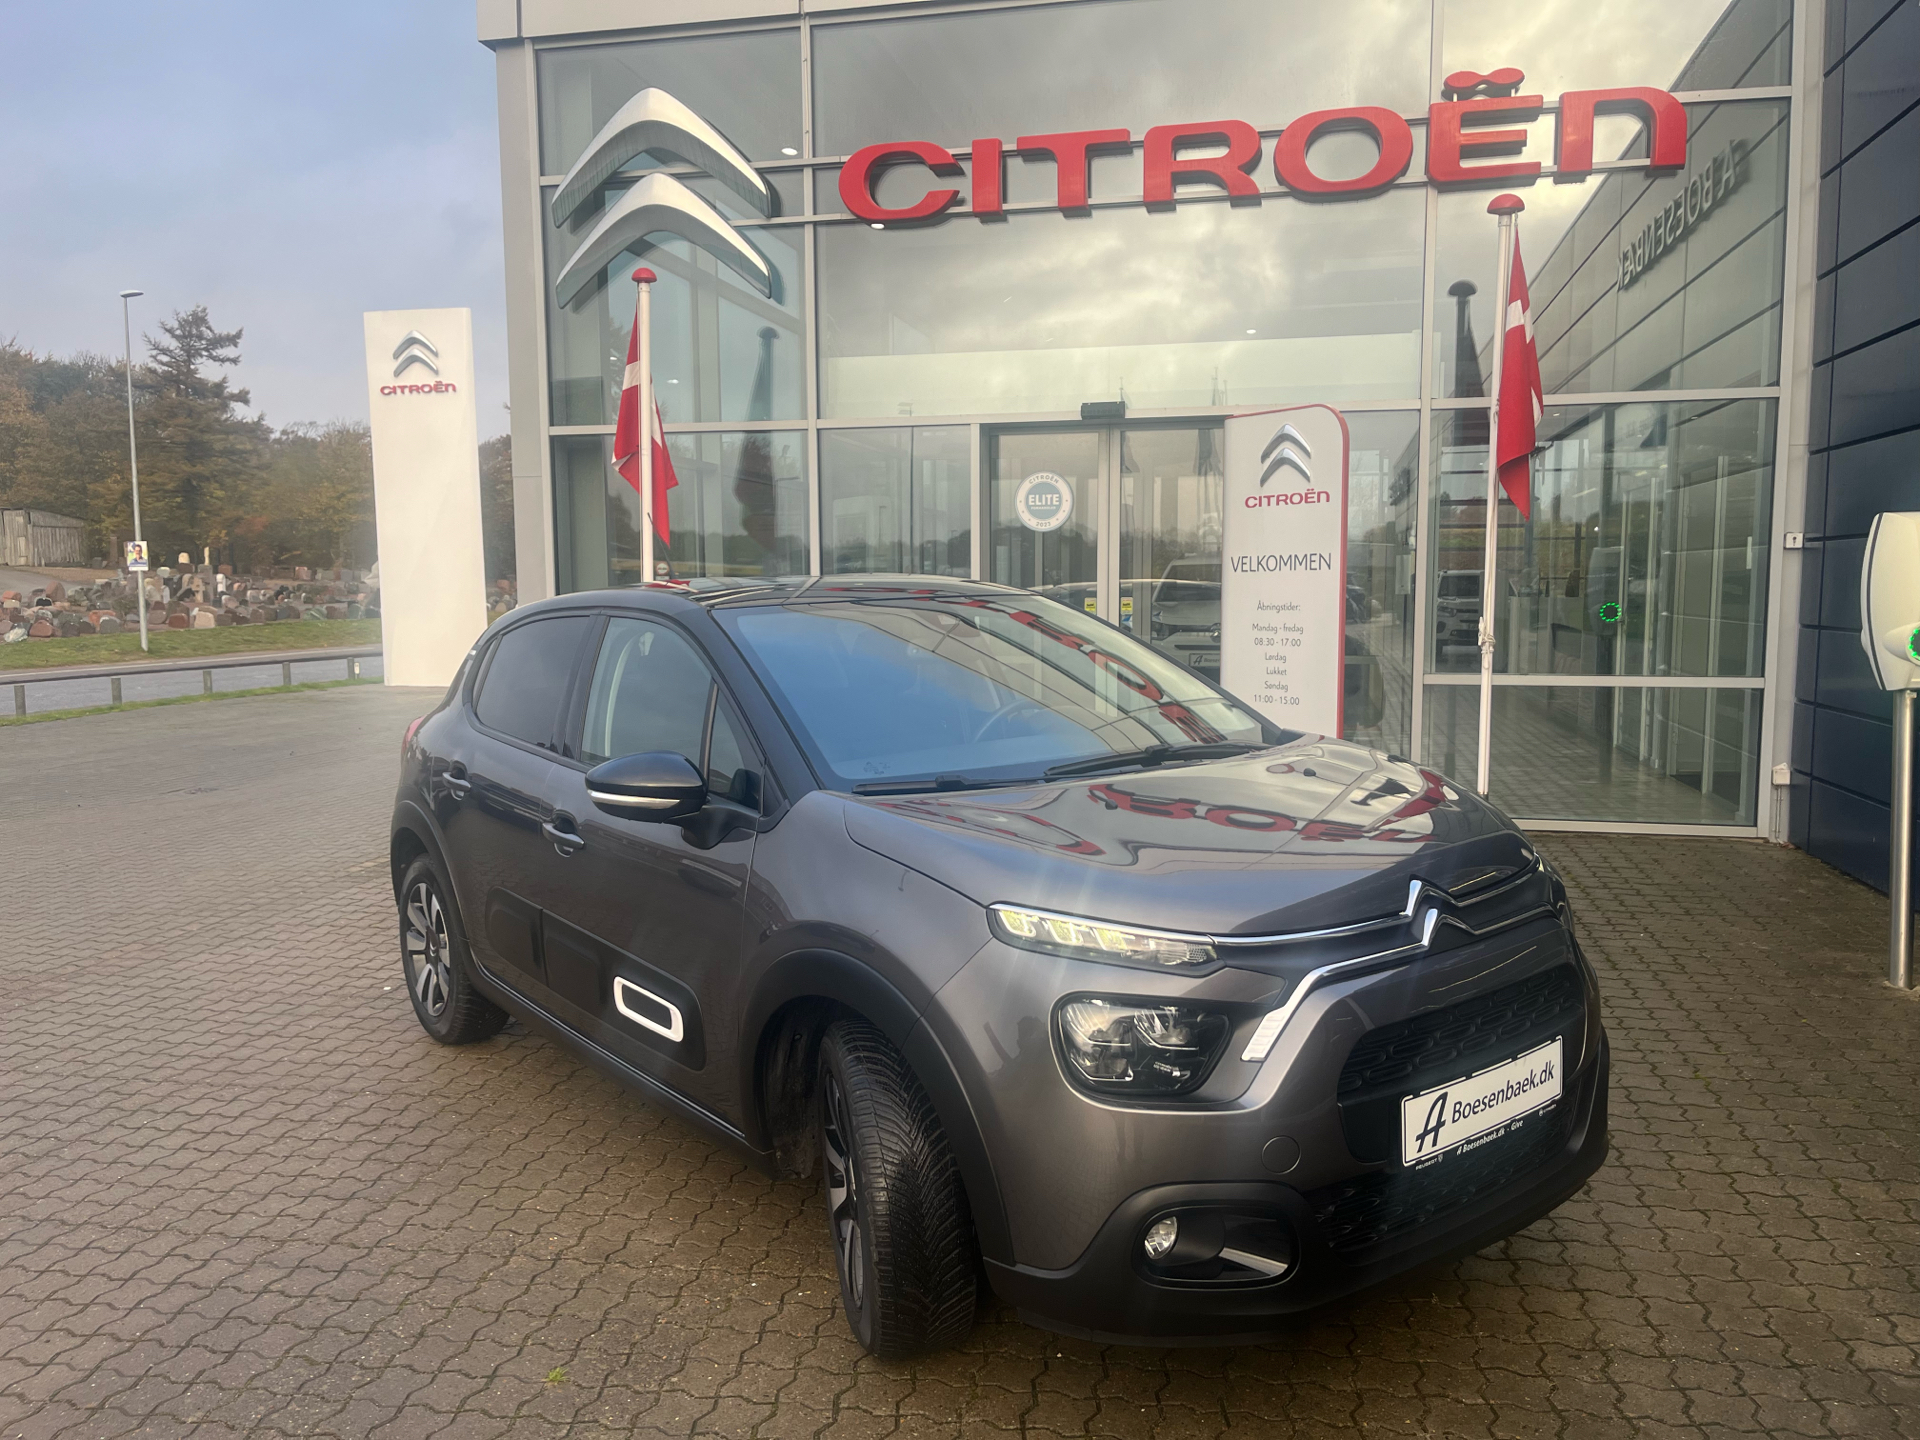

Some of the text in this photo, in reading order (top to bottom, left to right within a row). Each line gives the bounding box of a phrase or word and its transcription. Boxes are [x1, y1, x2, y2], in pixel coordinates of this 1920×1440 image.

[1029, 494, 1059, 505] ELITE
[1231, 553, 1332, 573] VELKOMMEN
[1257, 599, 1301, 614] Åbningstider:
[1252, 622, 1278, 635] Mandag
[1283, 622, 1304, 635] fredag
[1254, 637, 1275, 647] 08:30
[1281, 638, 1302, 648] 17:00
[1264, 651, 1287, 664] Lørdag
[1266, 666, 1288, 676] Lukket
[1264, 680, 1289, 693] Søndag
[1254, 694, 1273, 704] 11:00
[1279, 695, 1301, 706] 15:00
[1415, 1060, 1555, 1153] A Boesenbaek.dk
[1463, 1128, 1505, 1153] Boesenbaek.dk
[1510, 1120, 1524, 1131] Give
[1415, 1157, 1438, 1171] PEUGEOT
